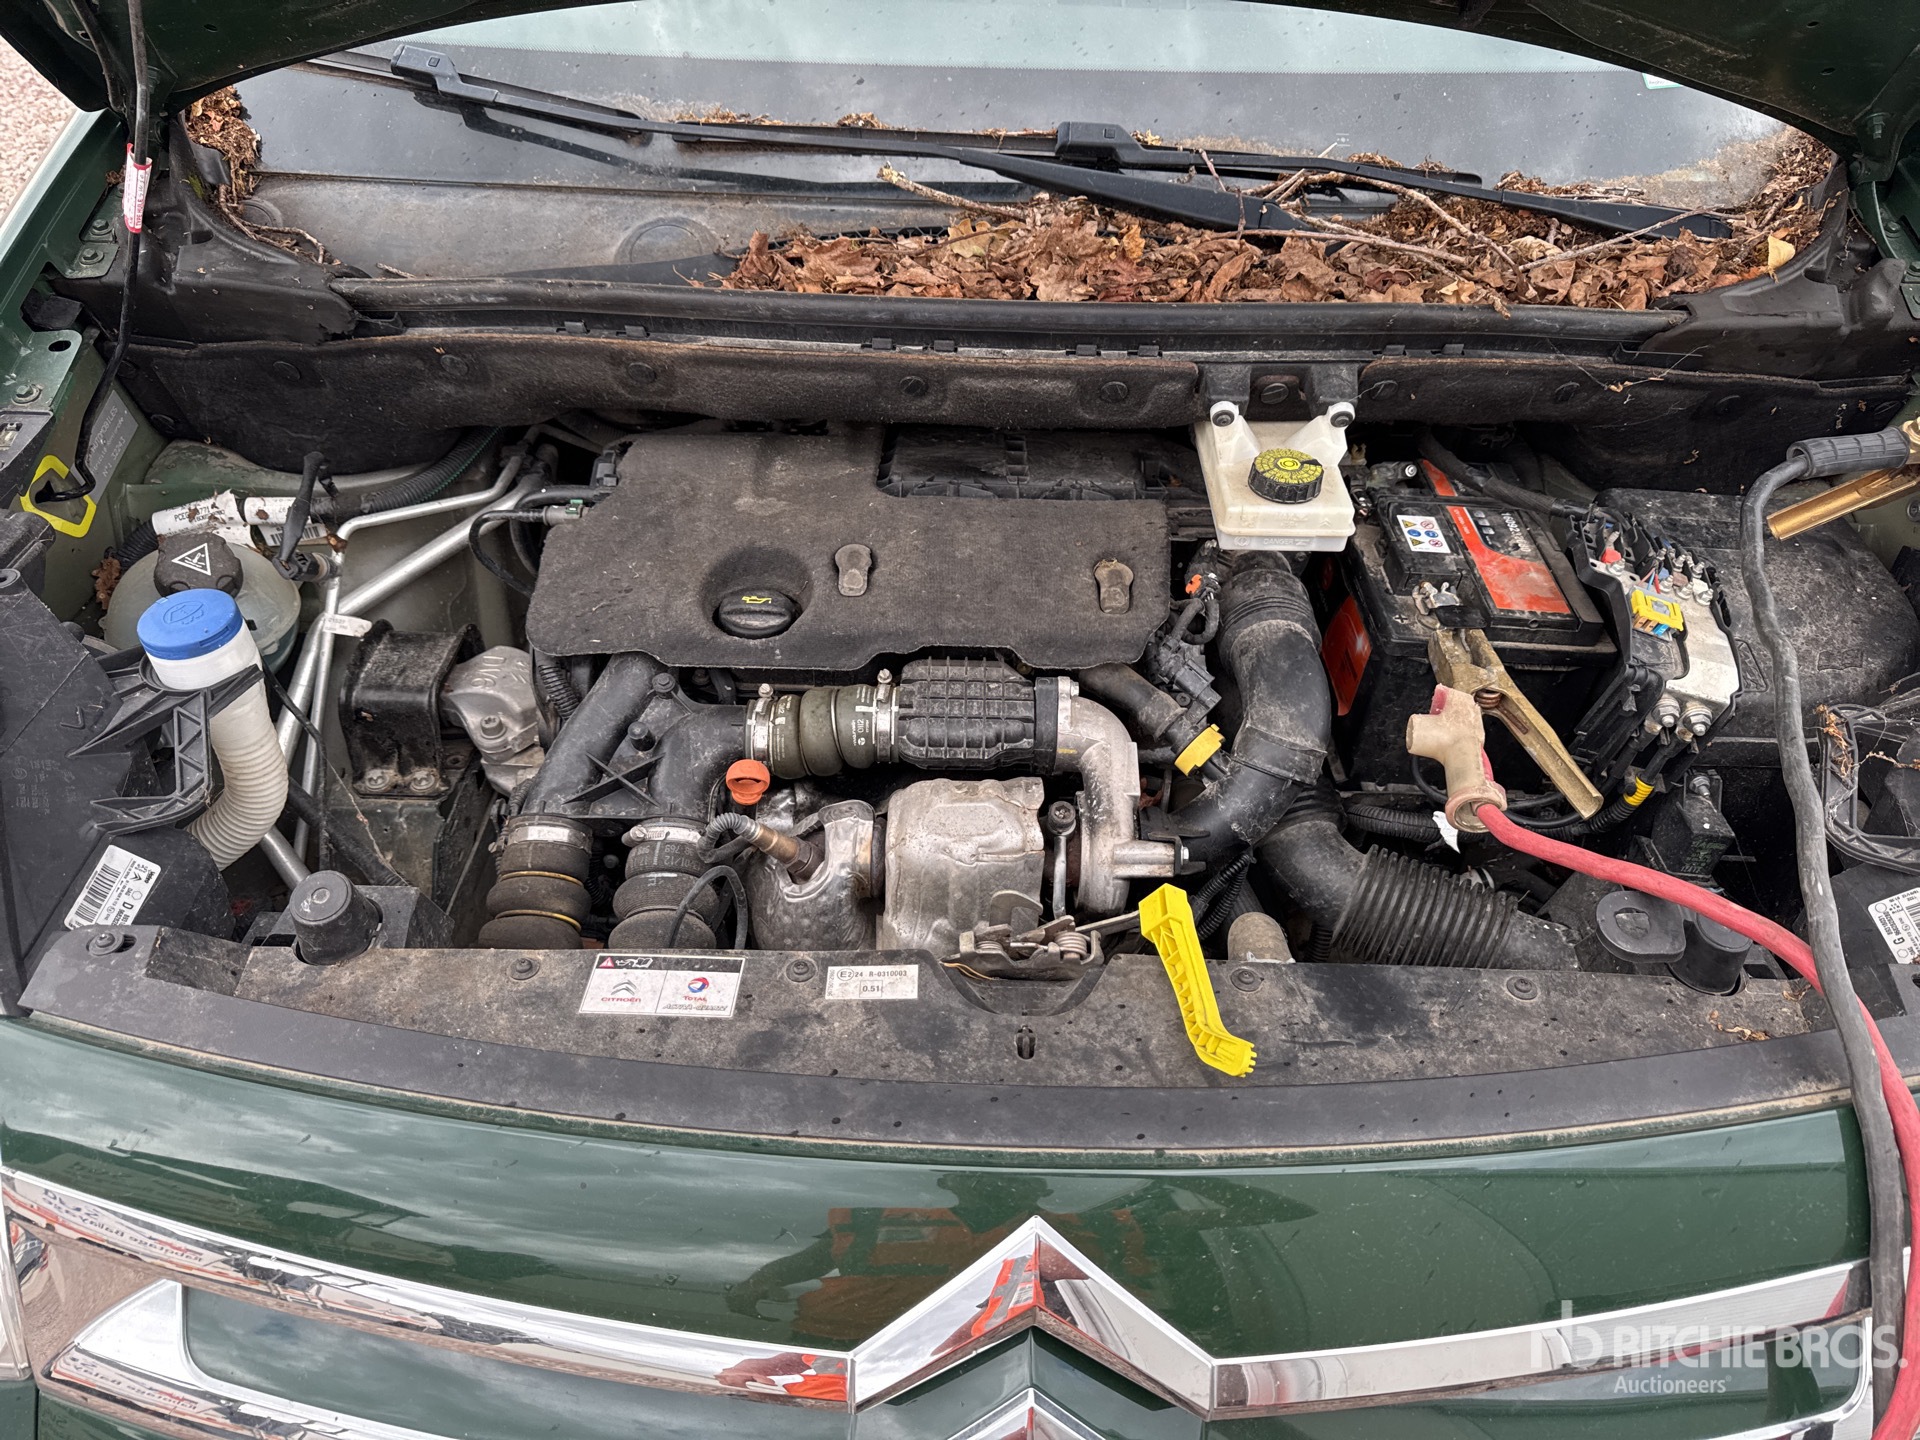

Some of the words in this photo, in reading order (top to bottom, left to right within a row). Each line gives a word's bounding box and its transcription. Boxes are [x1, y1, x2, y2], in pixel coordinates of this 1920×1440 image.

[471, 656, 504, 688] DV6
[122, 901, 134, 911] D
[1893, 936, 1905, 946] G
